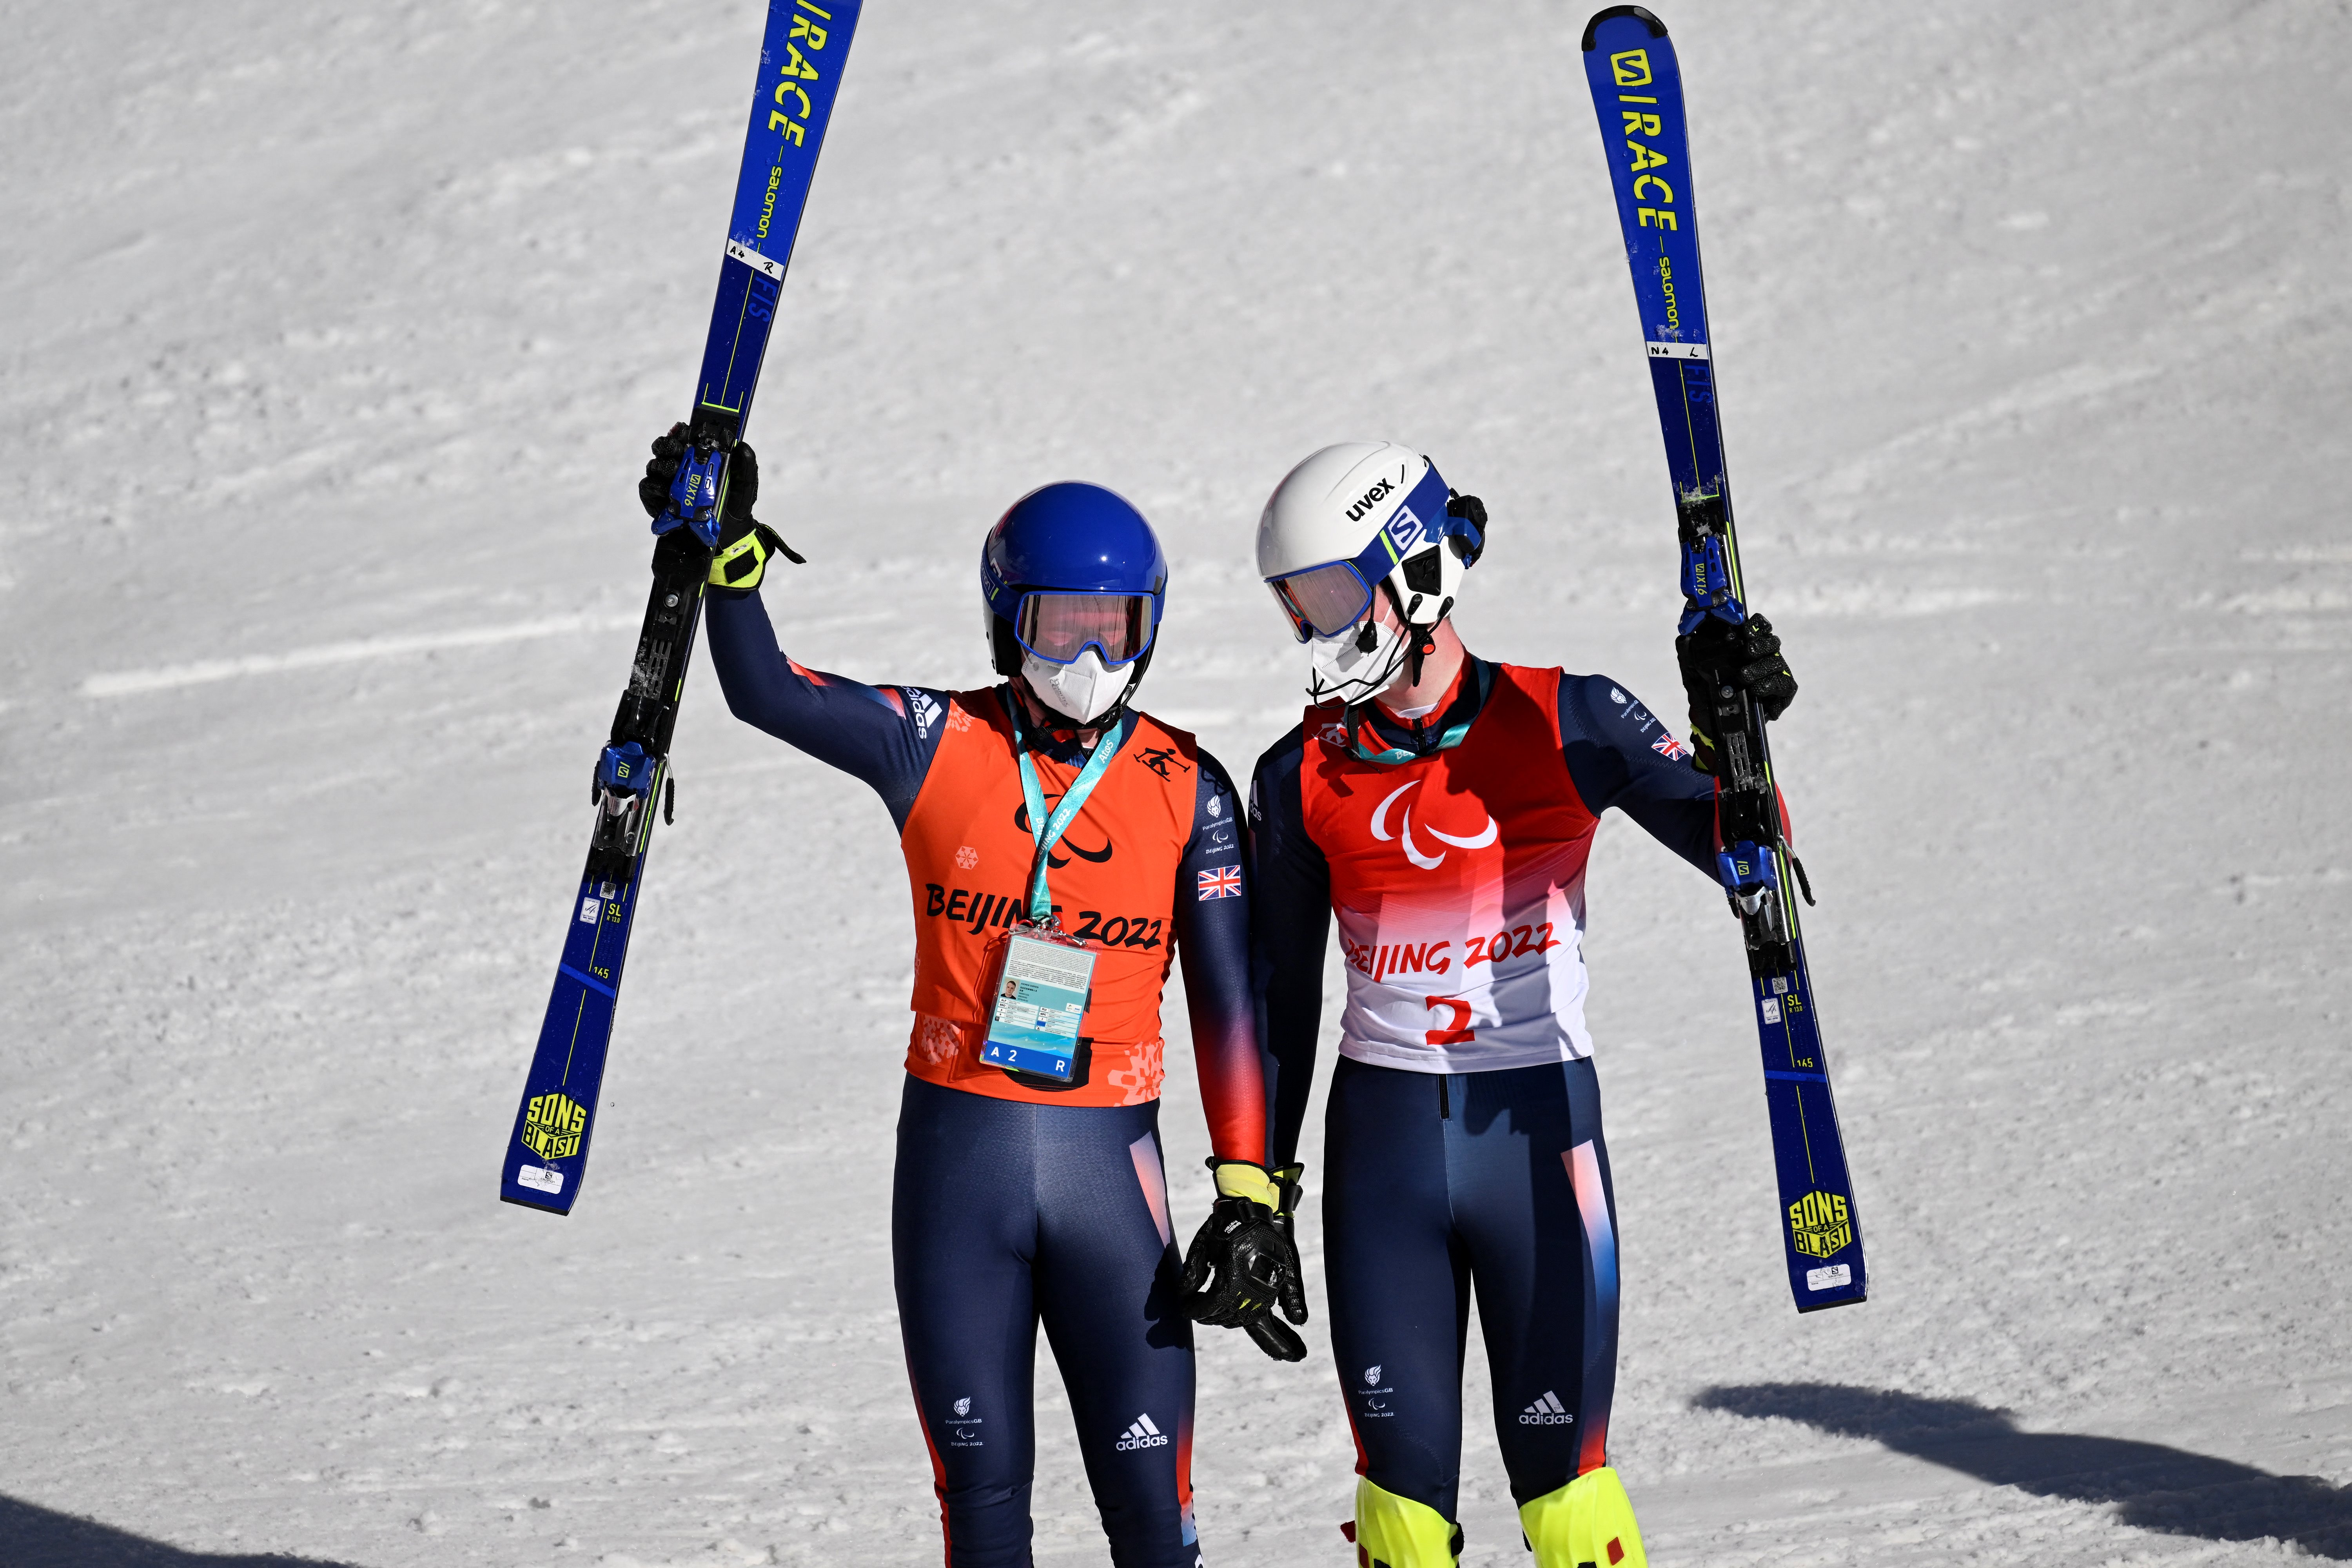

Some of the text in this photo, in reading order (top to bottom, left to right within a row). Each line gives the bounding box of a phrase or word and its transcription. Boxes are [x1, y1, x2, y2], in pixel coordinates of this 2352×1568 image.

[757, 166, 782, 238] salomon
[764, 261, 773, 274] R
[748, 276, 777, 322] FIS
[1659, 257, 1679, 330] salomon
[1690, 347, 1698, 357] L
[1685, 365, 1713, 403] FIS
[1345, 478, 1395, 522] uvex
[1621, 700, 1639, 718] ParalympicsGB
[1640, 721, 1651, 733] BEIJING
[1053, 808, 1071, 830] 2022
[1203, 817, 1232, 831] ParalympicsGB
[608, 903, 621, 916] SL
[1073, 911, 1161, 950] 2022
[1347, 922, 1562, 982] BEIJING 2022
[1787, 994, 1802, 1006] SL
[1425, 996, 1475, 1045] 2
[991, 1047, 1065, 1072] A 2 R
[527, 1093, 586, 1132] SONS
[523, 1123, 580, 1158] BLAST
[1789, 1191, 1848, 1229] SONS
[1227, 1222, 1241, 1234] SPEED
[1796, 1221, 1849, 1256] BLAST
[1519, 1412, 1573, 1425] adidas
[1116, 1435, 1168, 1451] adidas
